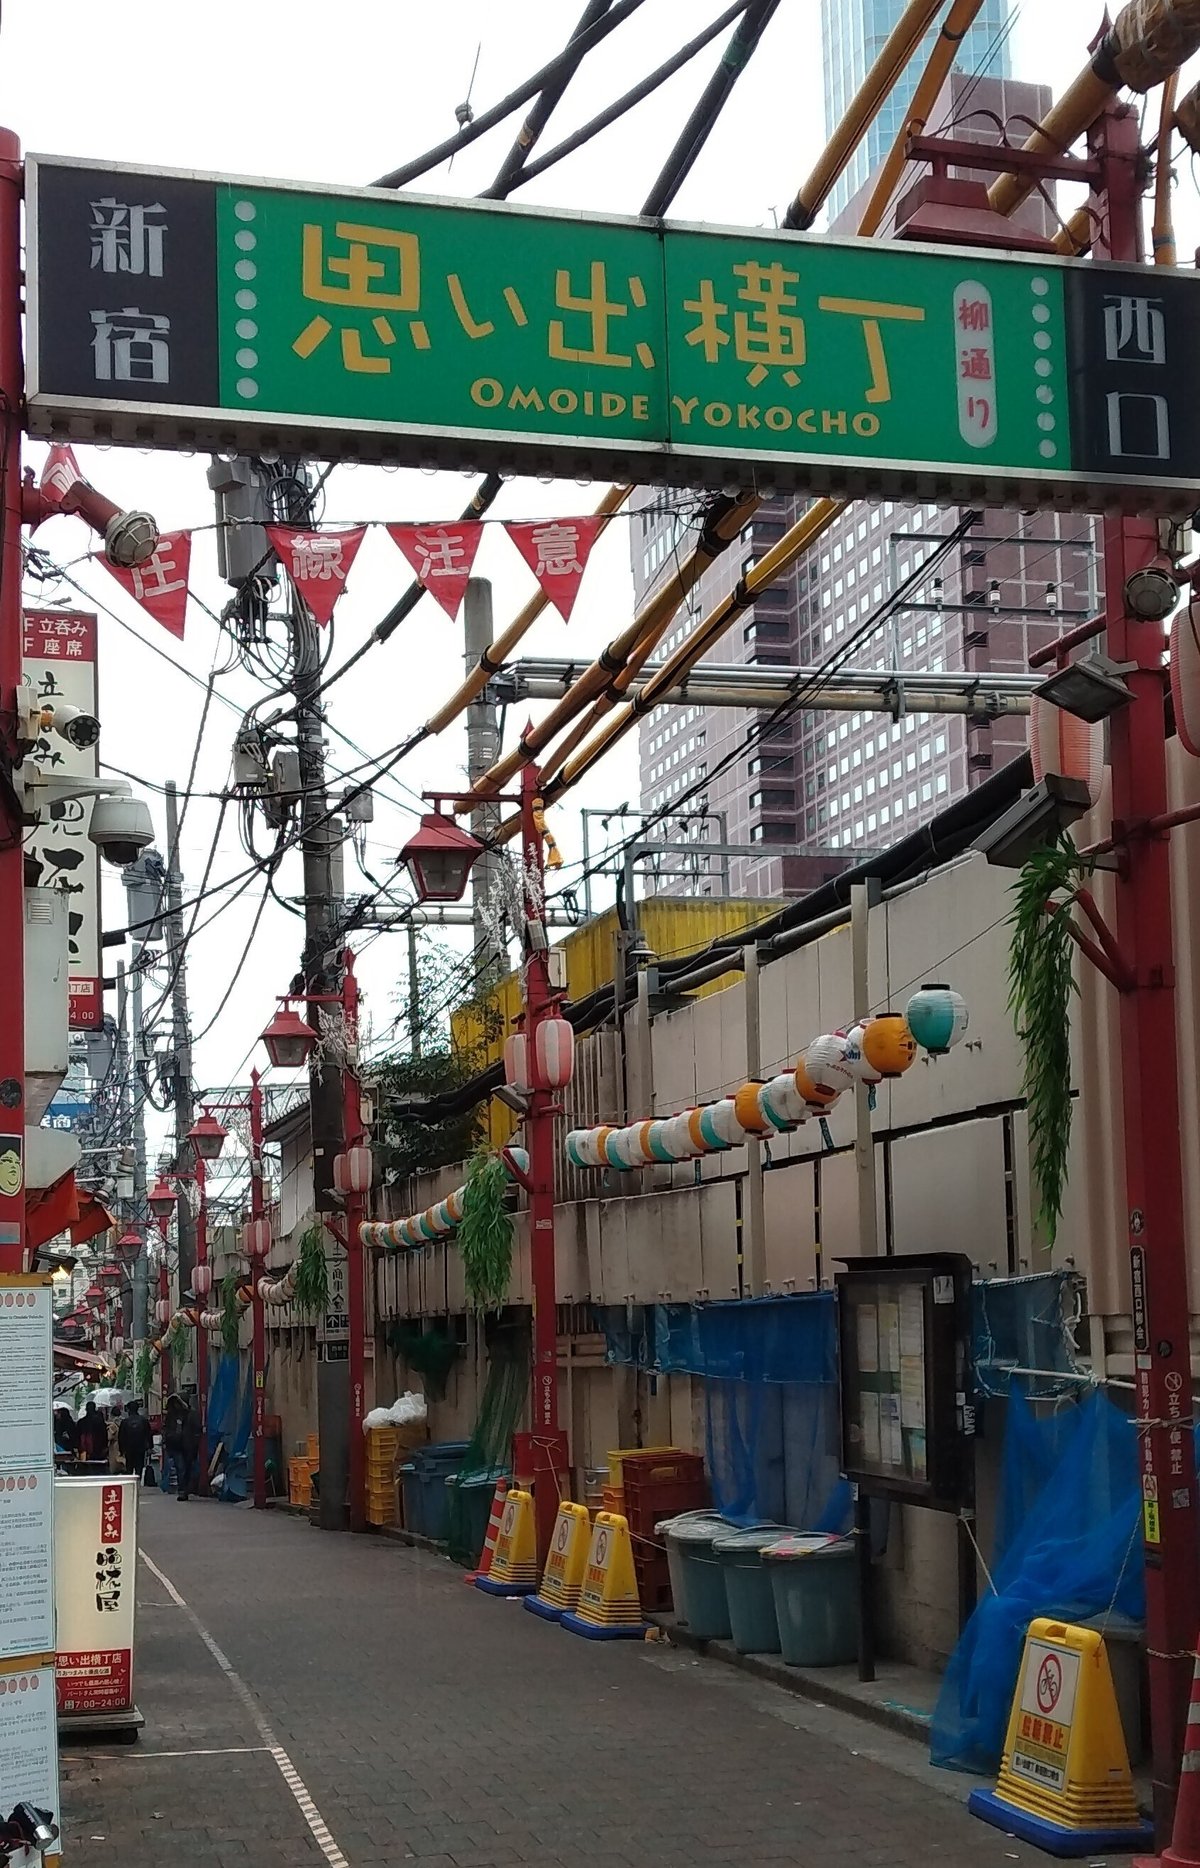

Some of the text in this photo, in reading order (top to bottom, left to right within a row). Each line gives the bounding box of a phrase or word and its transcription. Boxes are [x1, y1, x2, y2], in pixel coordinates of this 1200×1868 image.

[89, 196, 170, 384] 新宿
[292, 222, 925, 404] 思い出横丁
[470, 376, 881, 437] OMOIDE YOKOCHO
[958, 298, 994, 431] 柳通り
[1102, 294, 1171, 460] 西口
[38, 617, 88, 637] 立呑み
[33, 670, 66, 769] 立み
[68, 983, 91, 993] 丁店
[55, 1653, 122, 1667] 思い出横丁店
